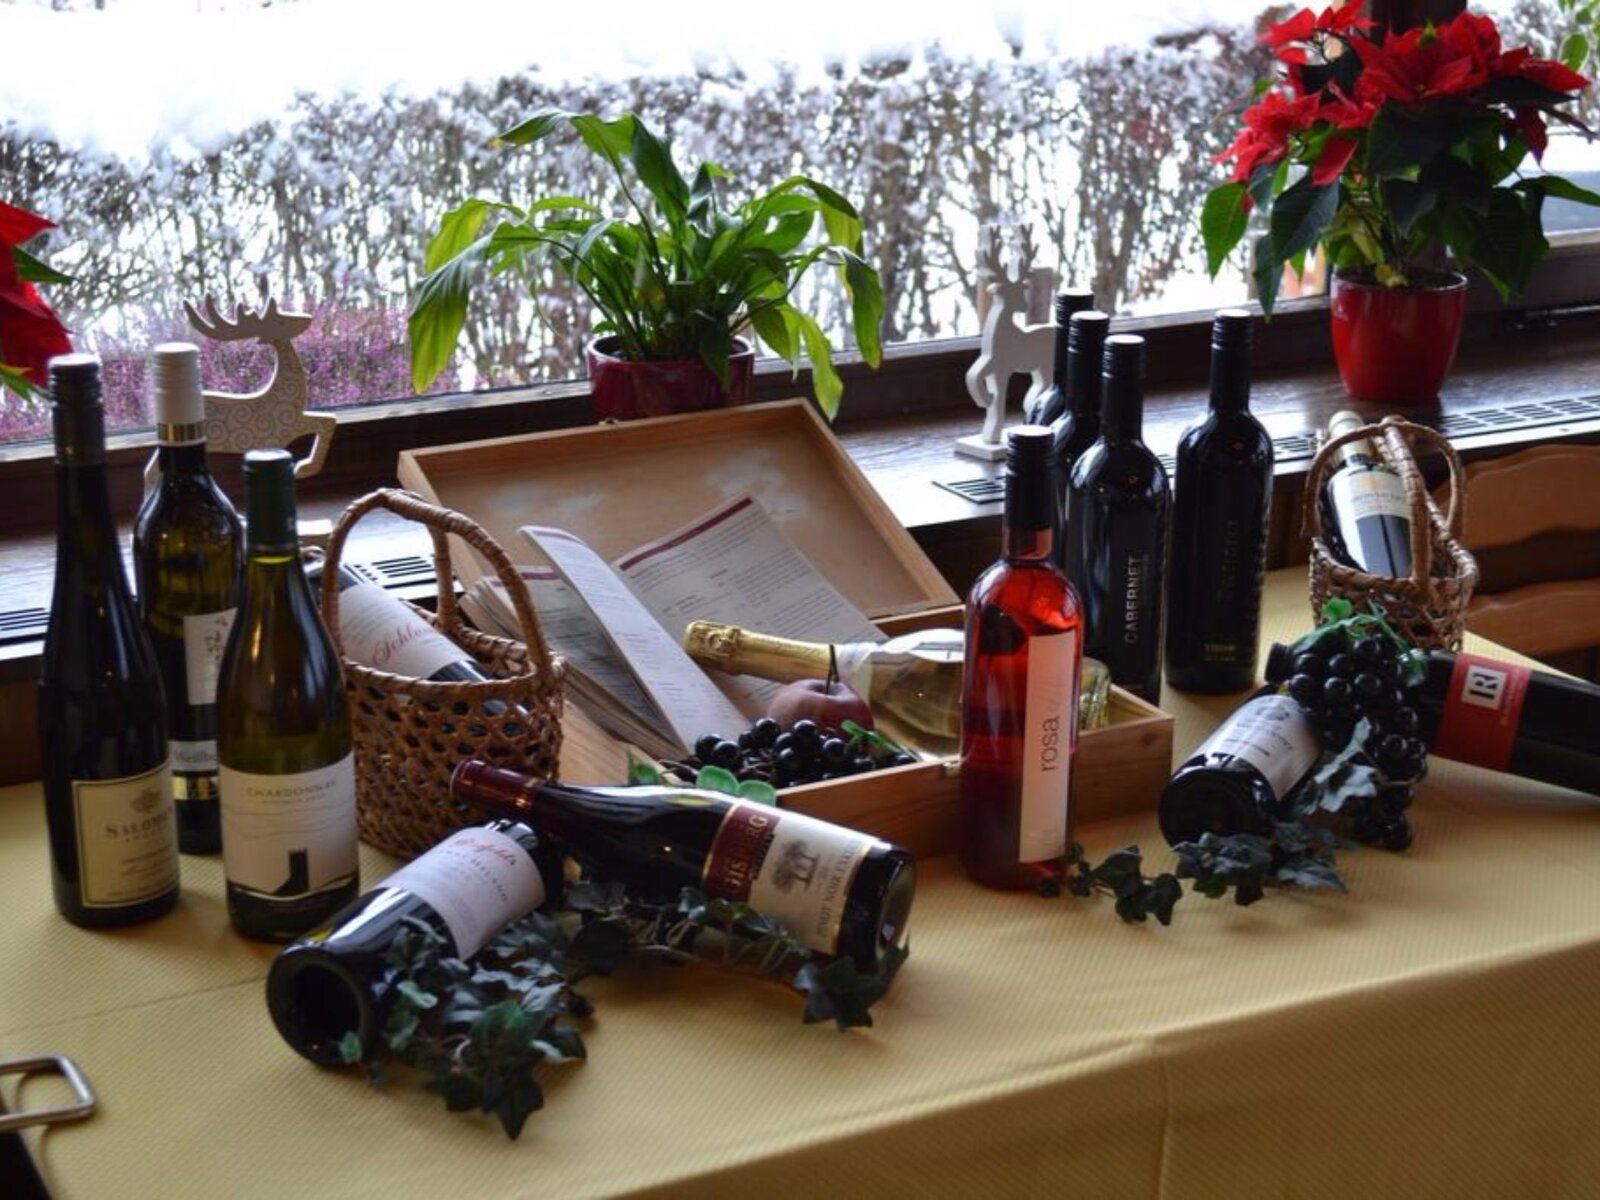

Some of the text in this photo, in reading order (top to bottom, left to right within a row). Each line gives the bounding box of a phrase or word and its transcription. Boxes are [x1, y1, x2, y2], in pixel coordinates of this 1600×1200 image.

[1124, 555, 1140, 643] CABERNET
[1041, 716, 1060, 772] rosa
[246, 780, 336, 797] CHARDONNAY
